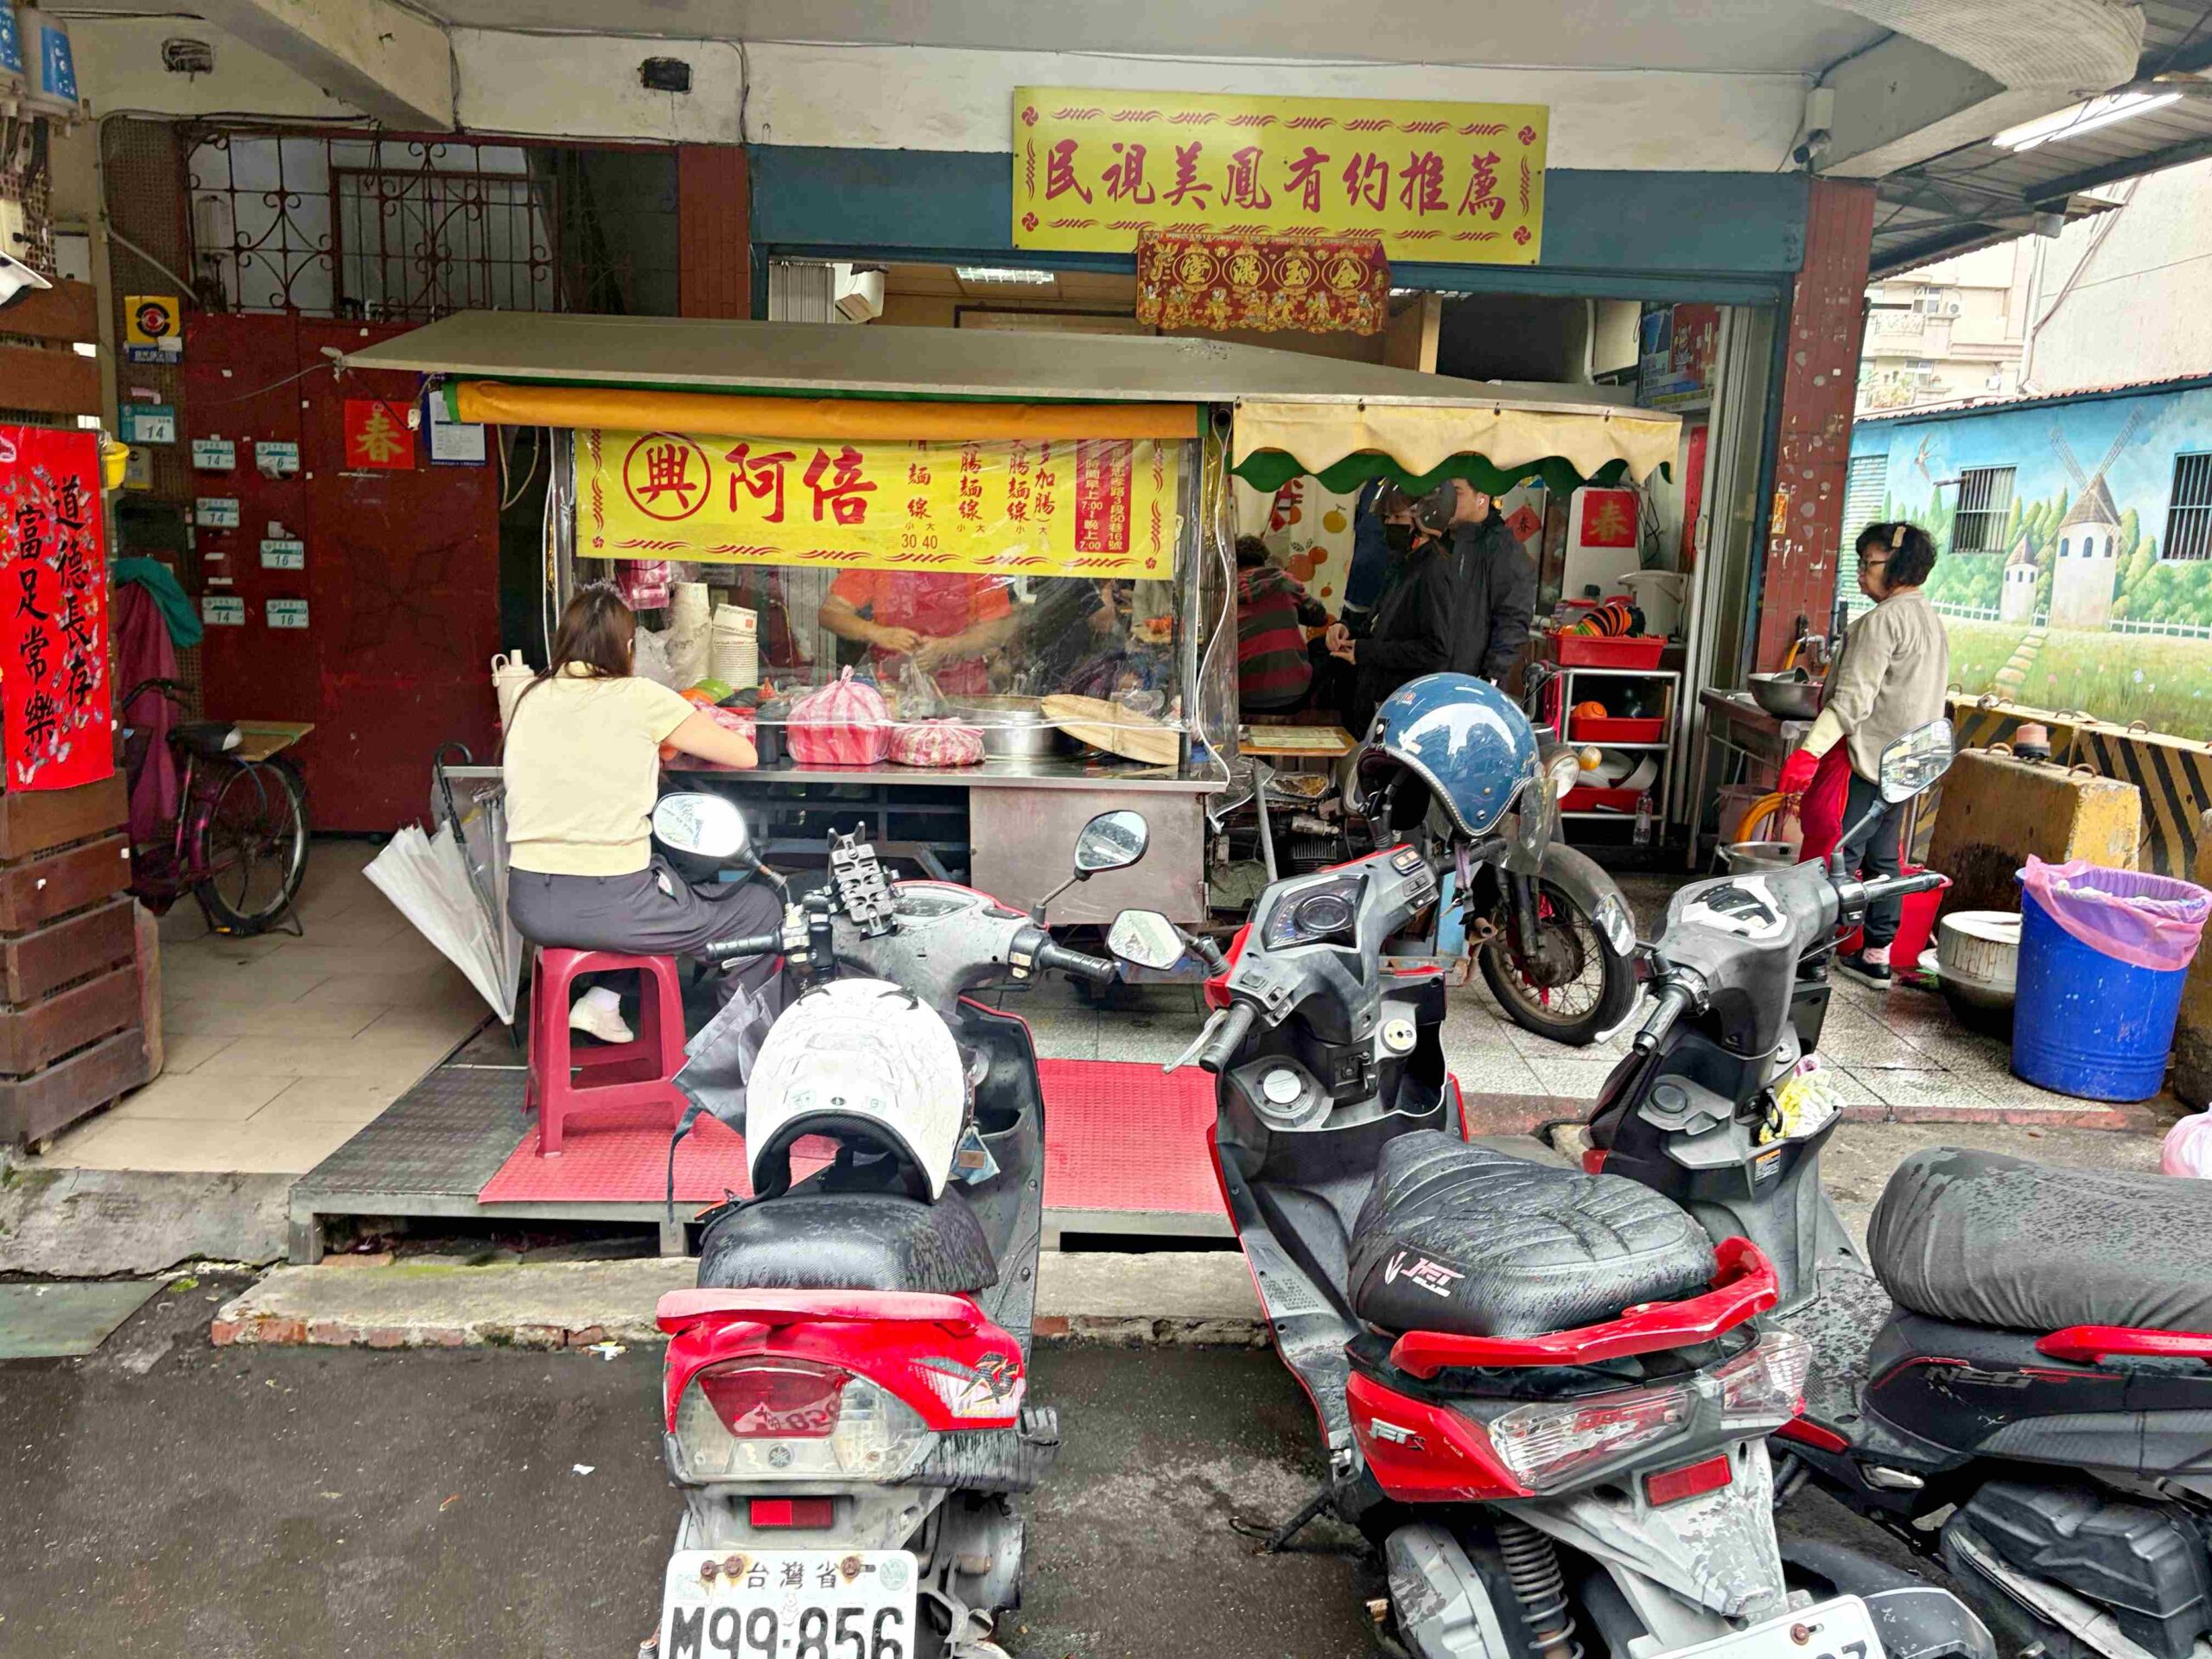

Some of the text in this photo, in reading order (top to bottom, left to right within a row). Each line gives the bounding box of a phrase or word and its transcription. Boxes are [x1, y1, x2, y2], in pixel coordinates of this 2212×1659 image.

[1045, 138, 1507, 219] 民視美鳳有約推薦
[147, 425, 164, 439] 14
[355, 410, 406, 462] 春
[725, 442, 878, 526] 阿倍
[901, 533, 938, 550] 30 40
[1588, 500, 1630, 542] 春
[15, 504, 56, 758] 富足常樂
[747, 1560, 839, 1589] 台灣省
